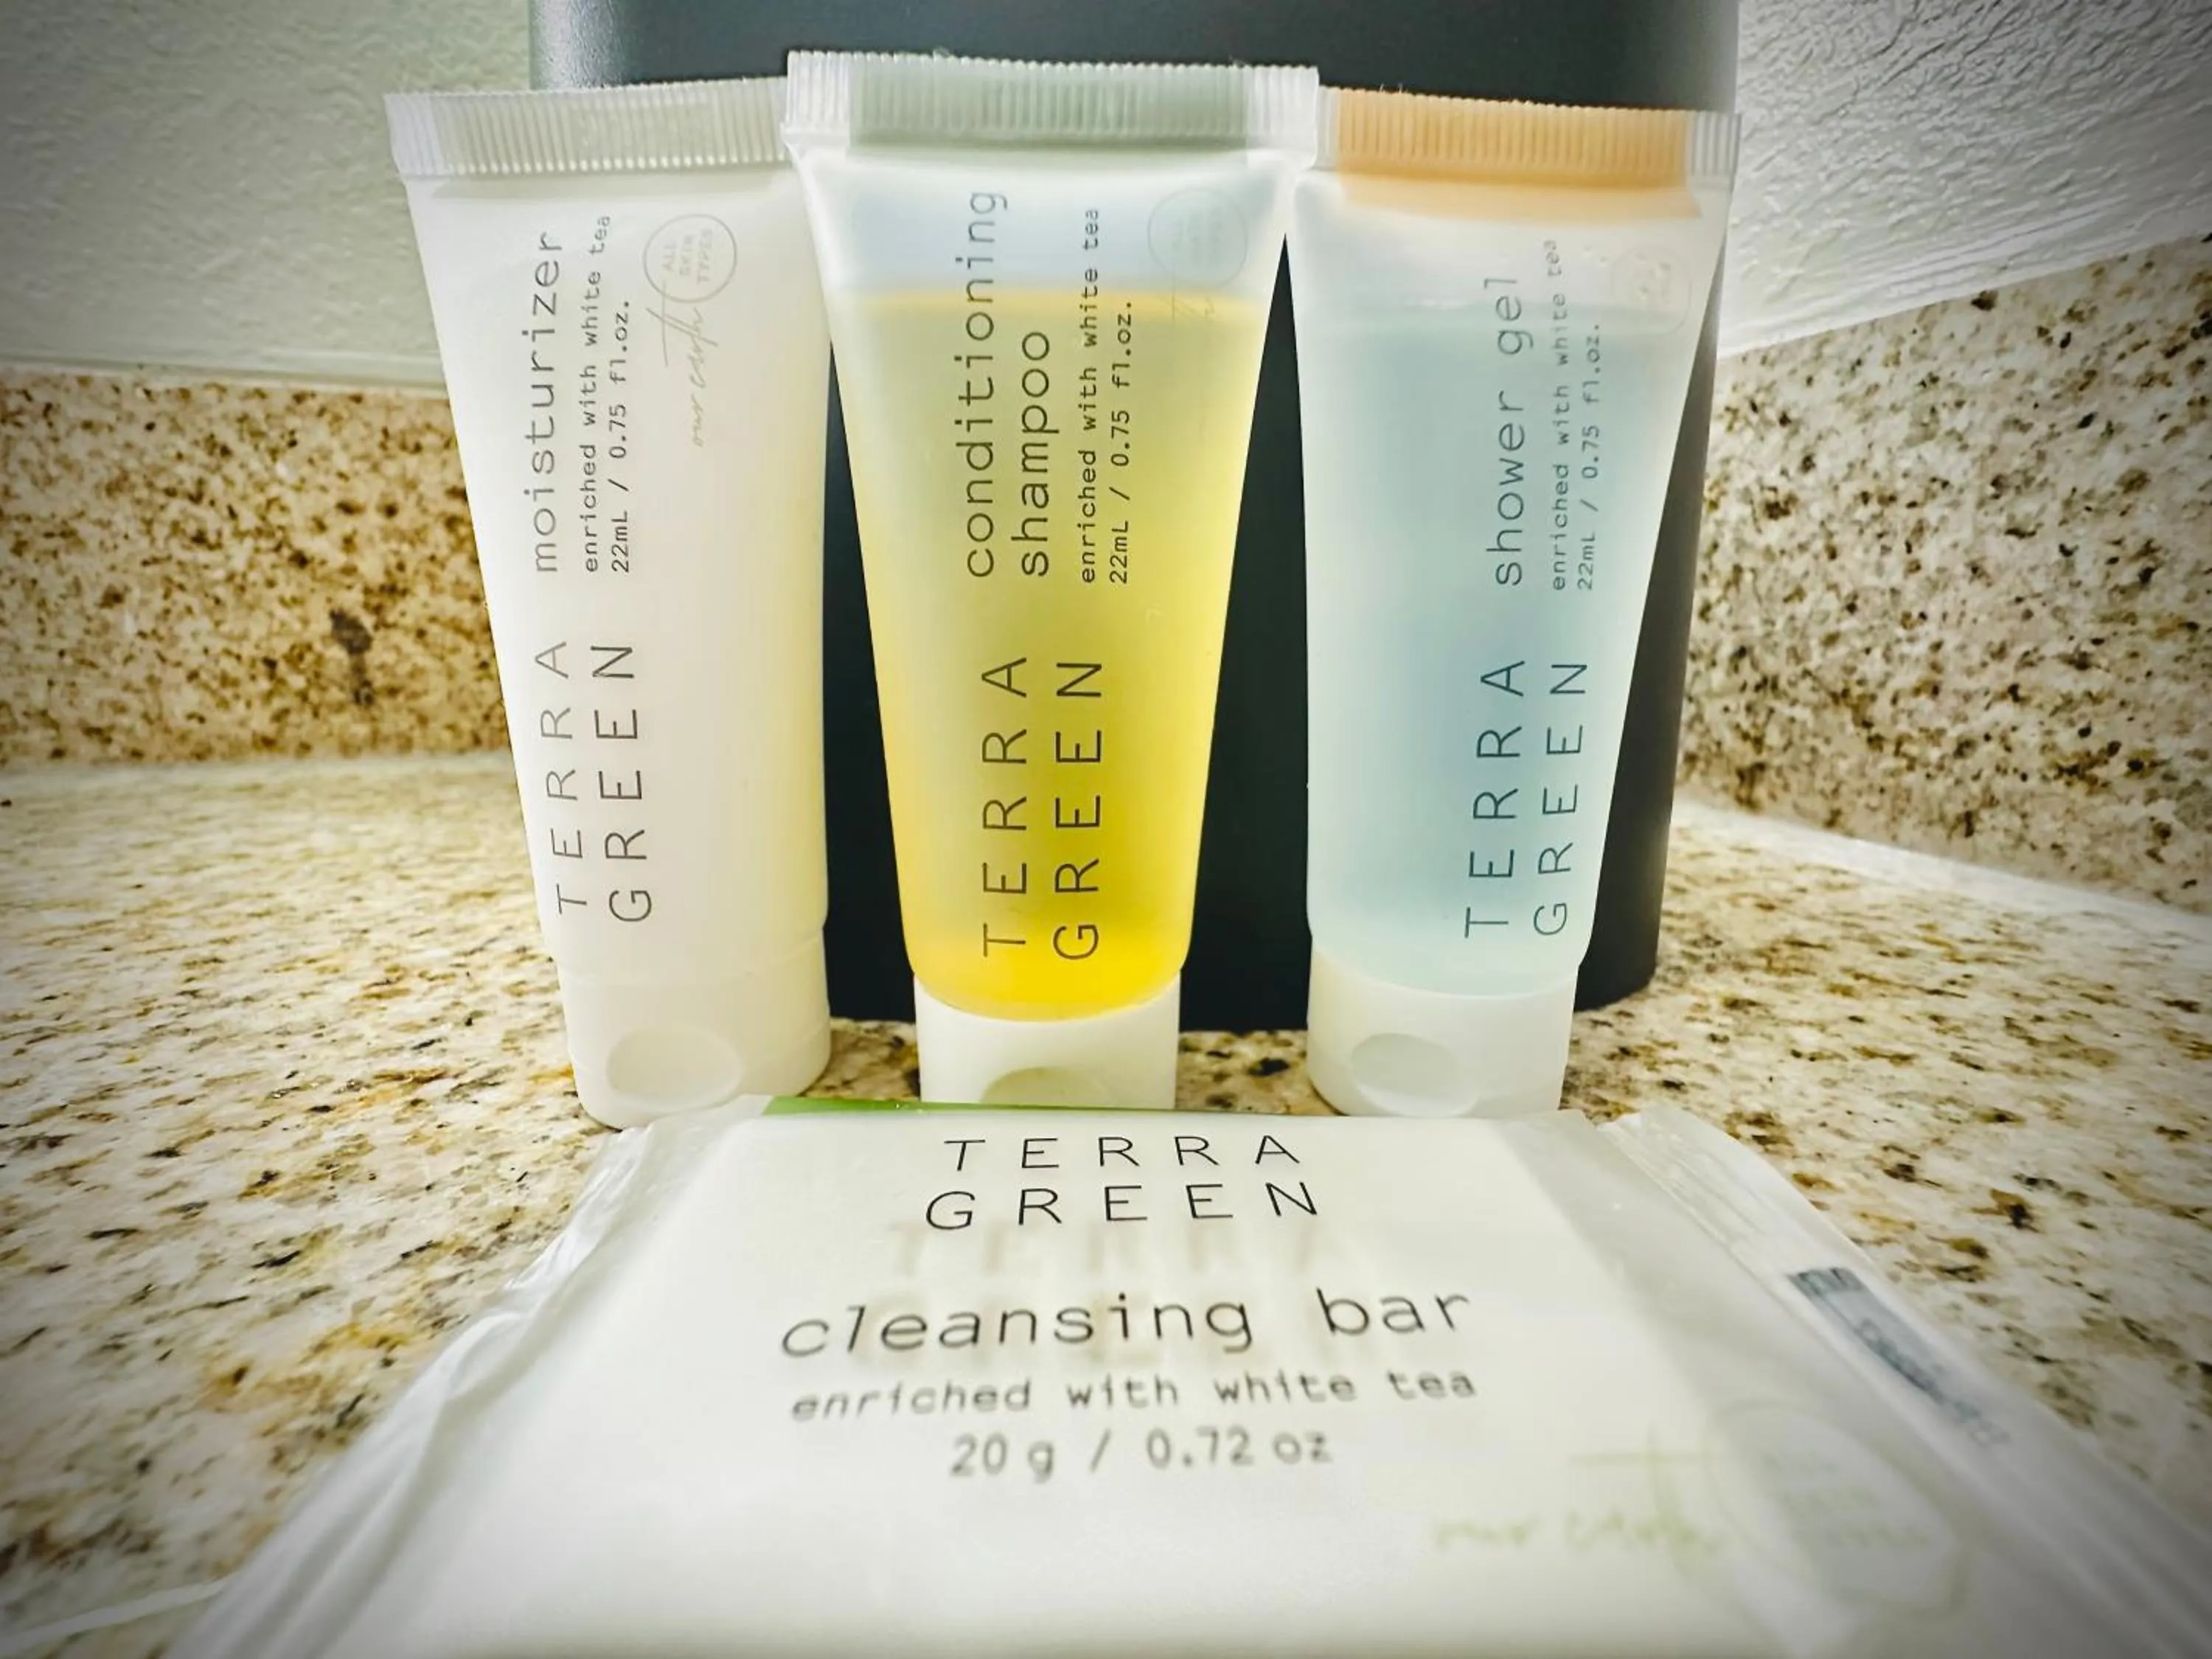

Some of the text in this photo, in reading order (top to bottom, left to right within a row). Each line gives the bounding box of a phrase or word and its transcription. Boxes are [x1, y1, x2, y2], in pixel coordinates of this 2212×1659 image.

[1551, 293, 1569, 366] white
[521, 231, 563, 572] moisturizer
[579, 215, 611, 573] enriched with white tea
[954, 191, 1008, 577] conditioning
[1077, 208, 1099, 585] enriched with white tea
[1551, 384, 1570, 446] with
[608, 405, 627, 459] 0.75
[1011, 331, 1060, 577] shampoo
[1110, 408, 1130, 468] 0.75
[1484, 276, 1534, 587] shower gel
[1582, 425, 1600, 480] 0.75
[608, 478, 630, 492] /
[1109, 486, 1131, 501] /
[1579, 498, 1599, 512] /
[611, 510, 630, 574] 22mL
[1109, 520, 1130, 585] 22mL
[1551, 464, 1570, 591] enriched
[1576, 532, 1596, 591] 22mL
[535, 641, 588, 915] TERRA
[590, 645, 653, 923] GREEN
[981, 657, 1028, 957] TERRA
[1052, 661, 1103, 961] GREEN
[1464, 660, 1526, 939] TERRA
[1533, 664, 1588, 936] GREEN
[943, 1135, 1301, 1172] TERRA
[925, 1181, 1318, 1230] GREEN
[780, 1287, 1472, 1360] cleansing bar
[790, 1366, 1477, 1423] enriched with white tea
[949, 1425, 1336, 1484] 20 g / 0.72 oz
